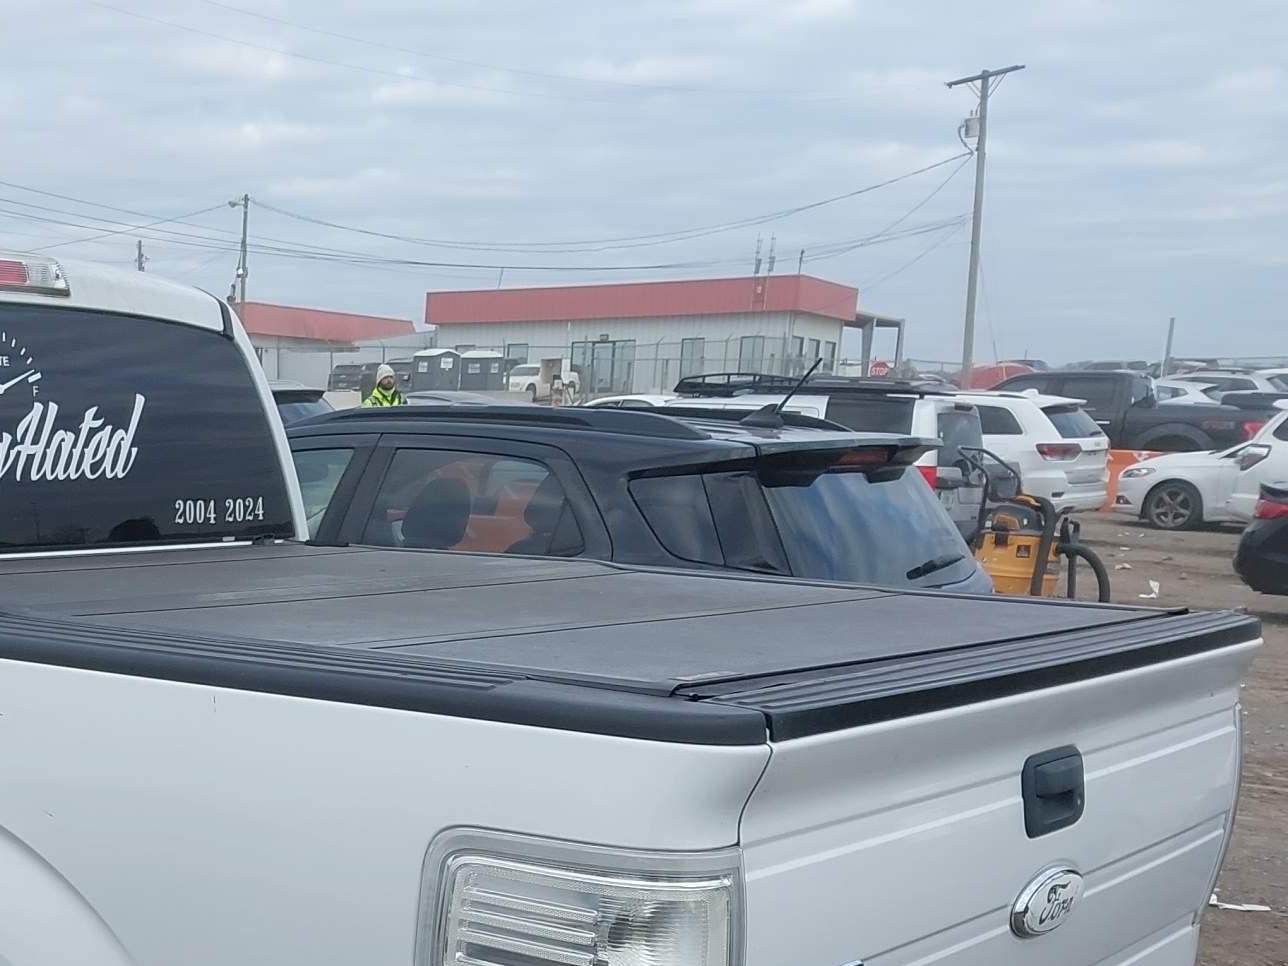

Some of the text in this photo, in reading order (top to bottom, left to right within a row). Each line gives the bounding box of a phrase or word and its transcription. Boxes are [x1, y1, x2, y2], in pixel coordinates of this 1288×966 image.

[871, 367, 889, 376] STOP
[32, 385, 40, 397] F
[175, 496, 264, 524] 2004 2024
